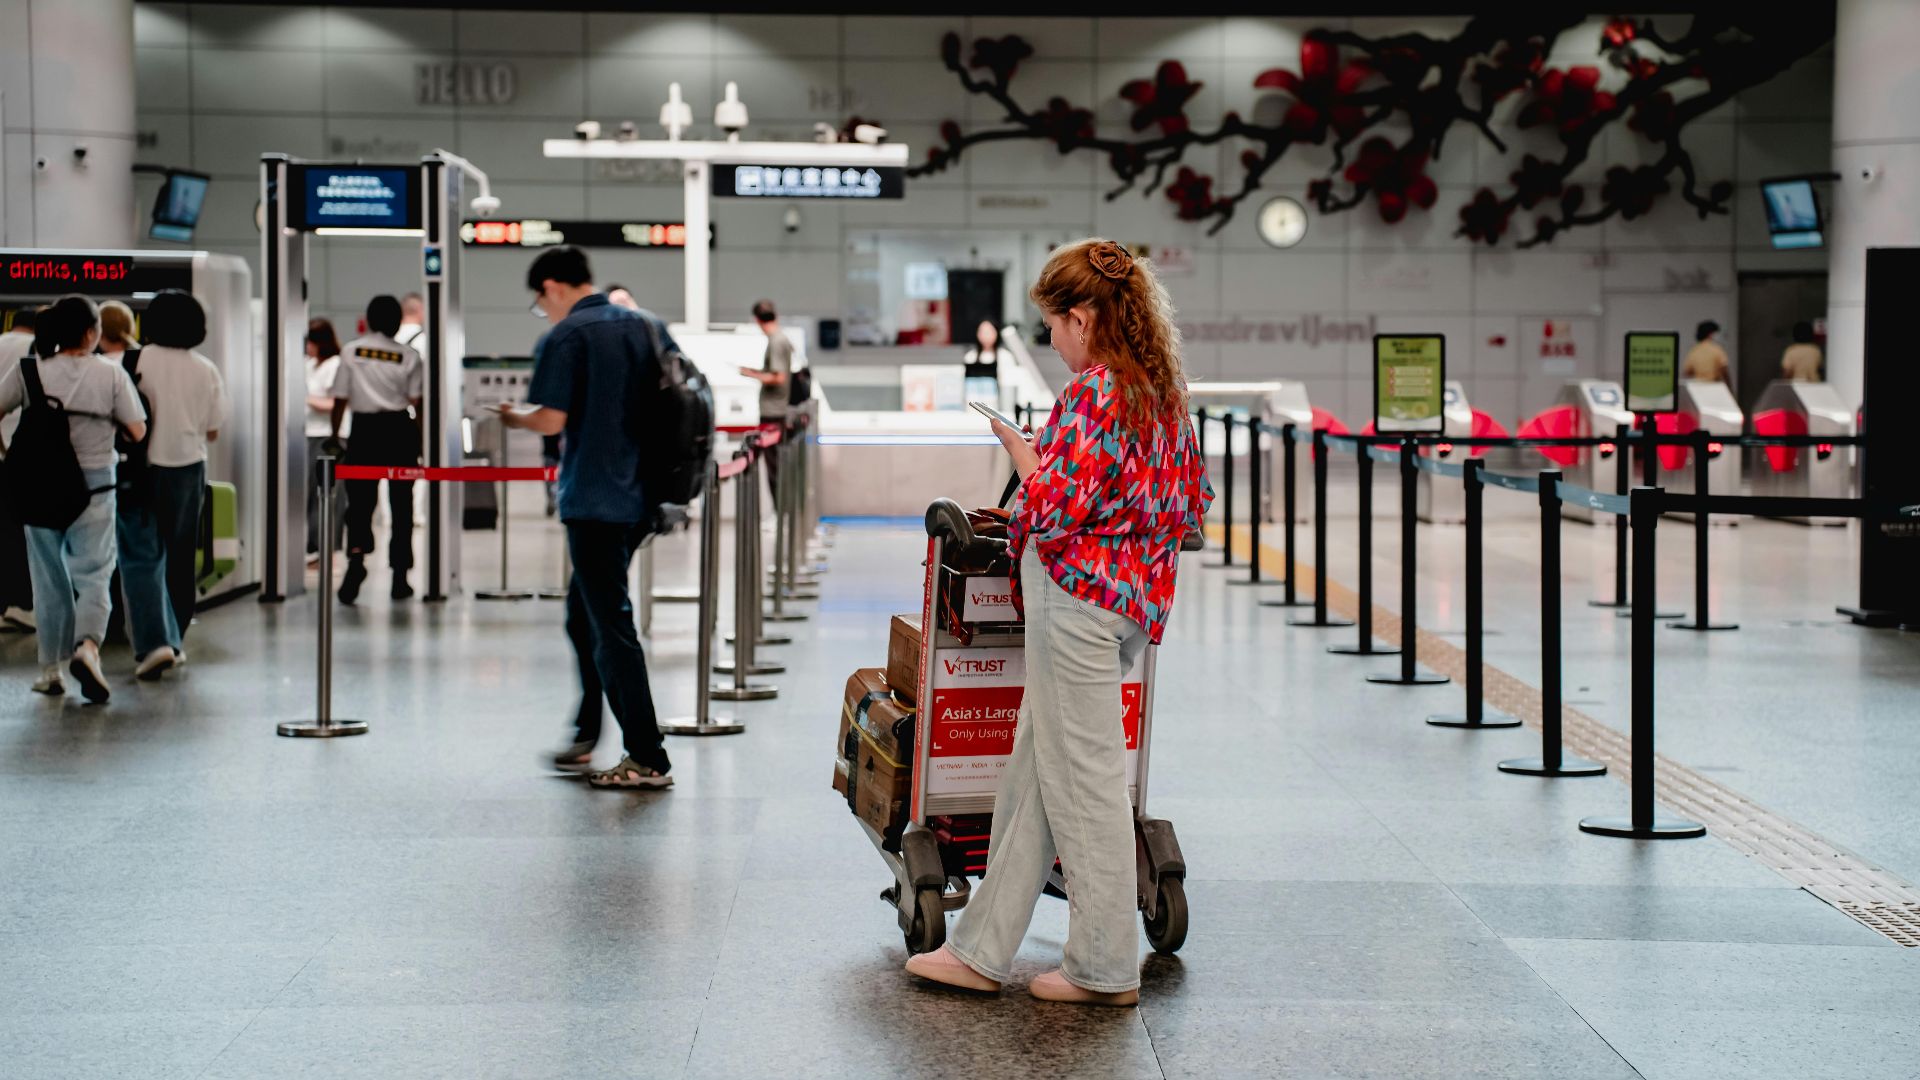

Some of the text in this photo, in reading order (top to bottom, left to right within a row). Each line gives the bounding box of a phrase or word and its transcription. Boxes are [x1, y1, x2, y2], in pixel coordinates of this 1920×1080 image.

[415, 63, 516, 105] HELLO
[941, 706, 982, 720] Asia's
[949, 729, 975, 741] Only
[978, 728, 1009, 740] Using
